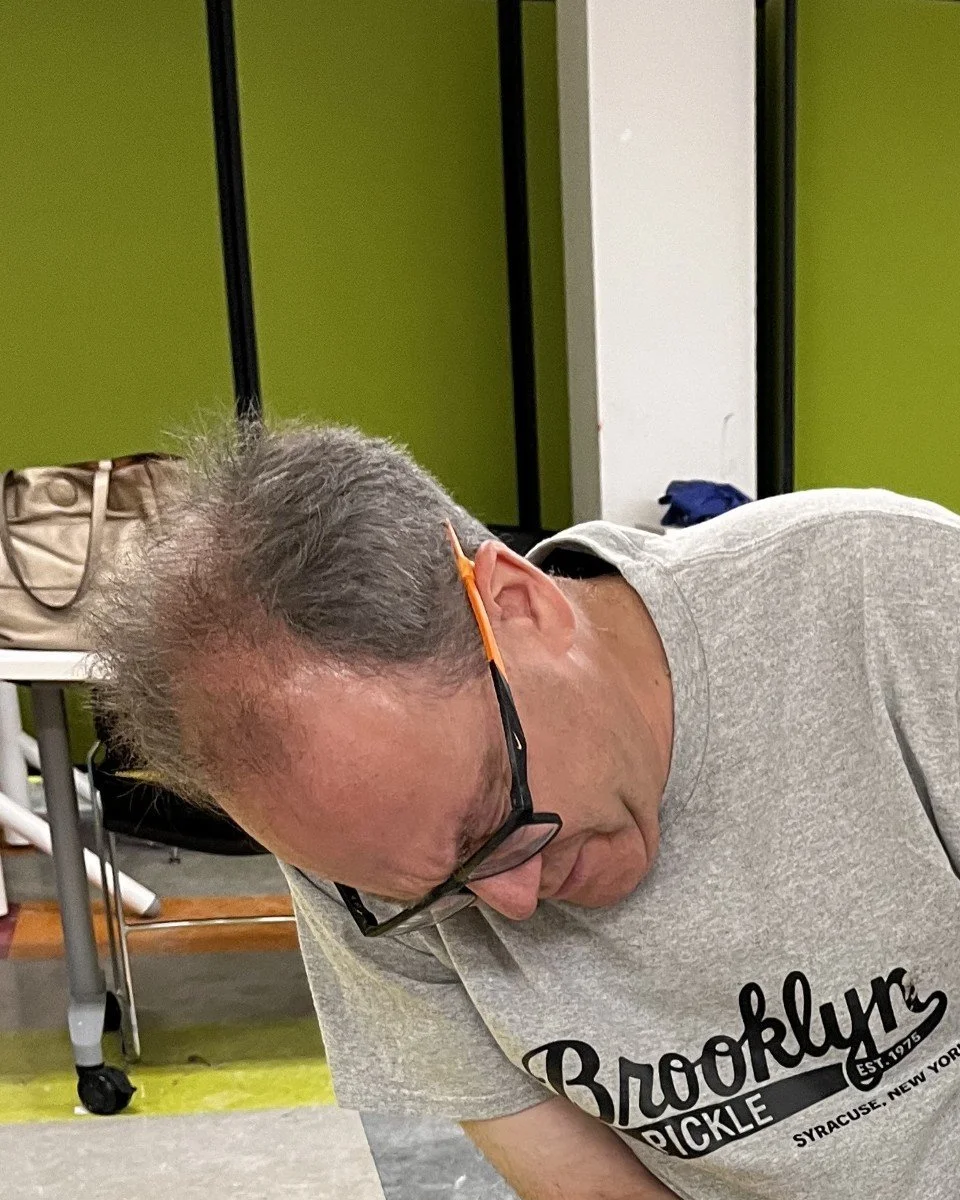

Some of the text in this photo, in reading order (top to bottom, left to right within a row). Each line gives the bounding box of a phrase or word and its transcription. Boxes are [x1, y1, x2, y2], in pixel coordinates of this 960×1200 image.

[521, 967, 948, 1128] Brooklyn
[856, 1031, 922, 1077] EST. 1975
[641, 1092, 774, 1156] PICKLE
[792, 1099, 887, 1148] SYRACUSE,
[887, 1070, 927, 1101] NEW
